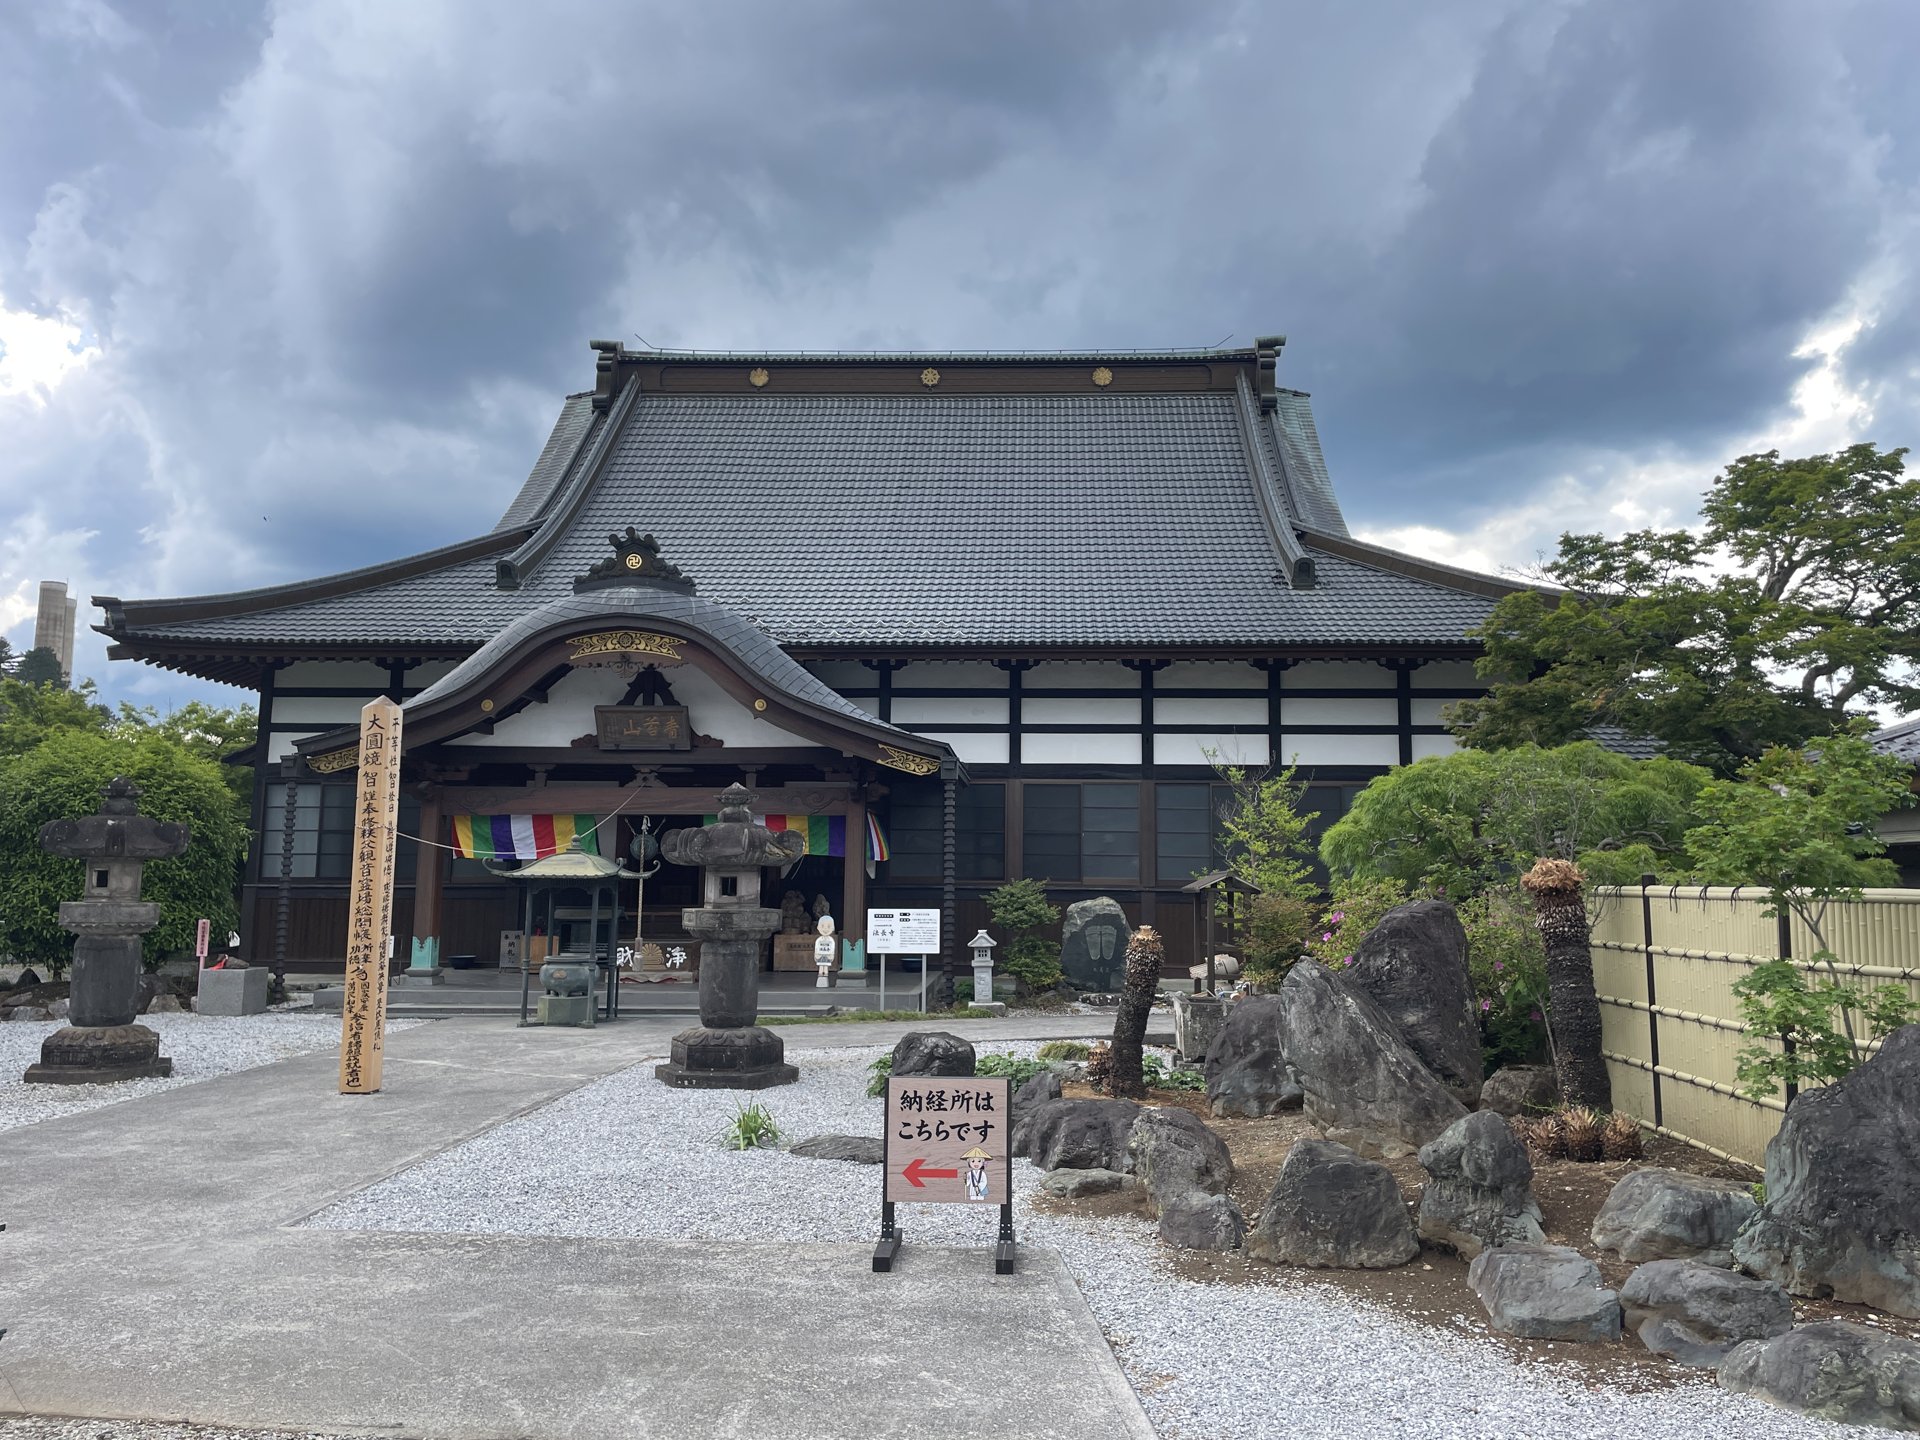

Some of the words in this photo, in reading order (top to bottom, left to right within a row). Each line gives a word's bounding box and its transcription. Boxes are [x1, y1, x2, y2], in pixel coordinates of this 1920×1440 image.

[900, 1089, 995, 1113] 納経所は
[898, 1120, 995, 1143] こちらです
